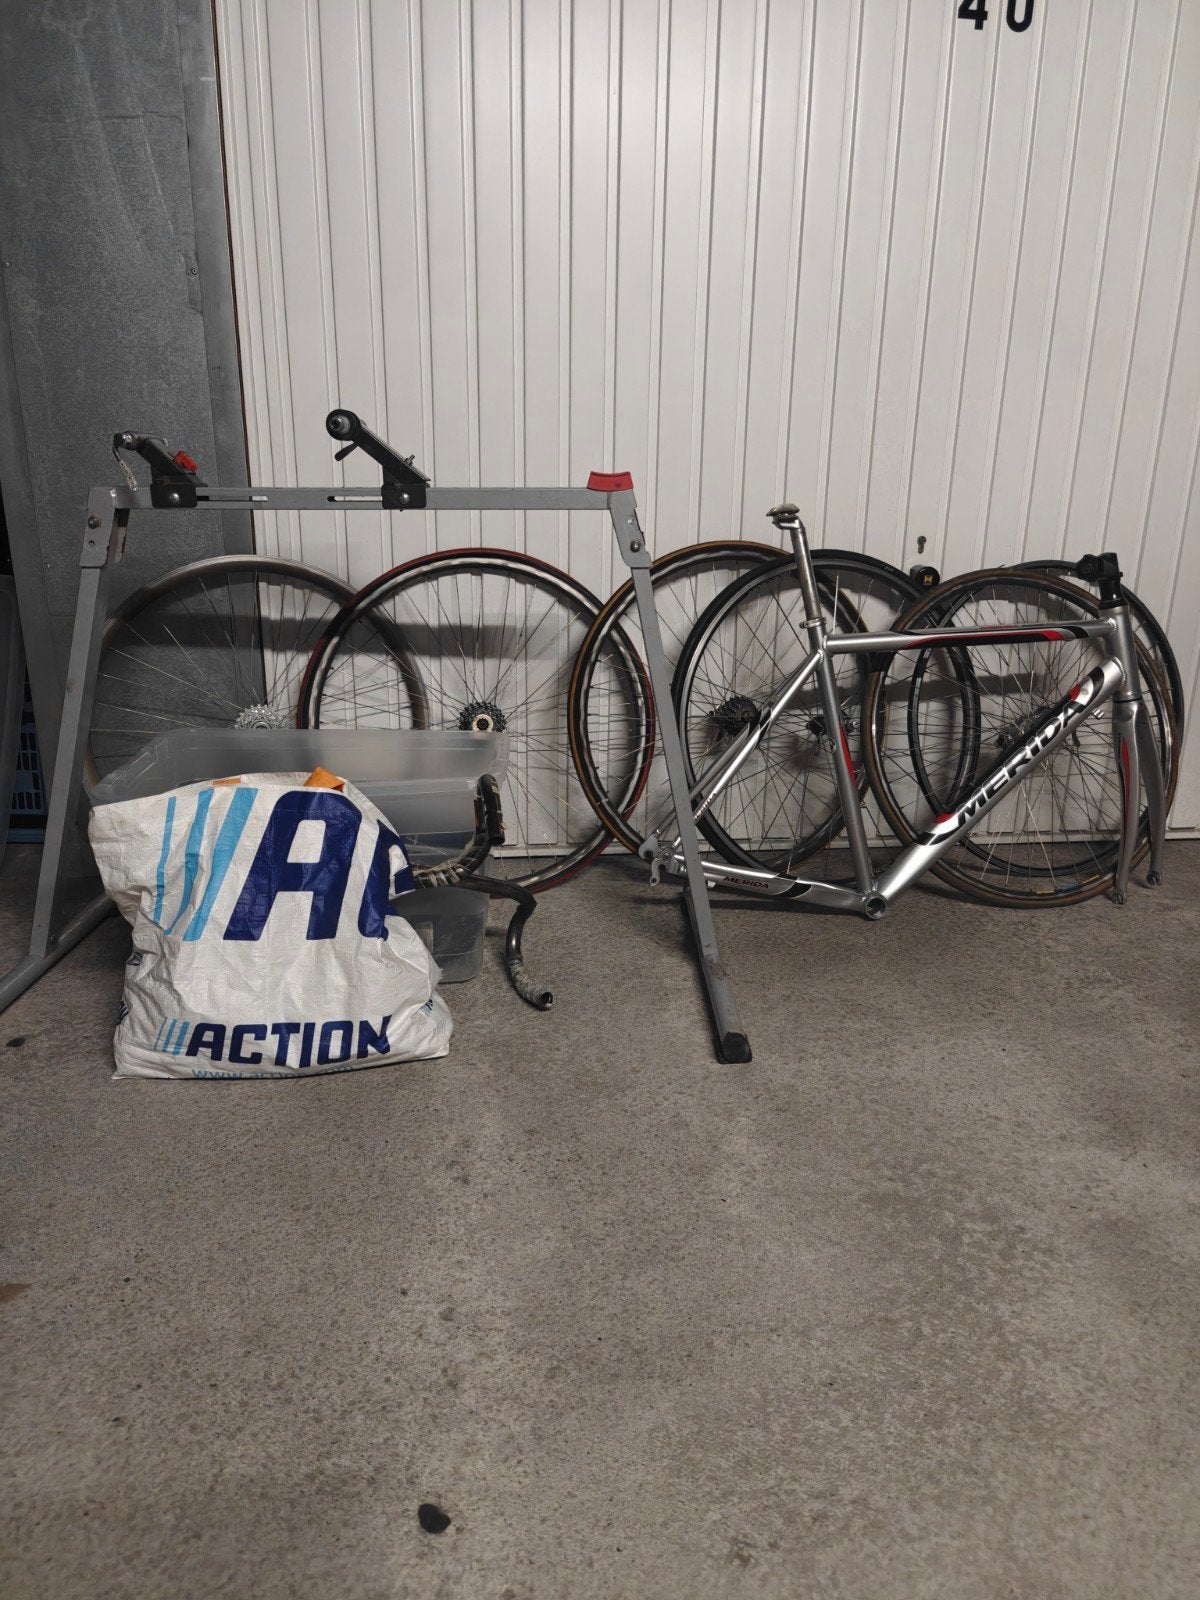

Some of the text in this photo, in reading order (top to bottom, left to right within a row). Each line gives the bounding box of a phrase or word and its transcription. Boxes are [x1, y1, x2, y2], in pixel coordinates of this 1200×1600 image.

[956, 700, 1085, 828] MERIDA
[722, 875, 769, 889] MERIDA
[185, 1014, 393, 1068] ACTION
